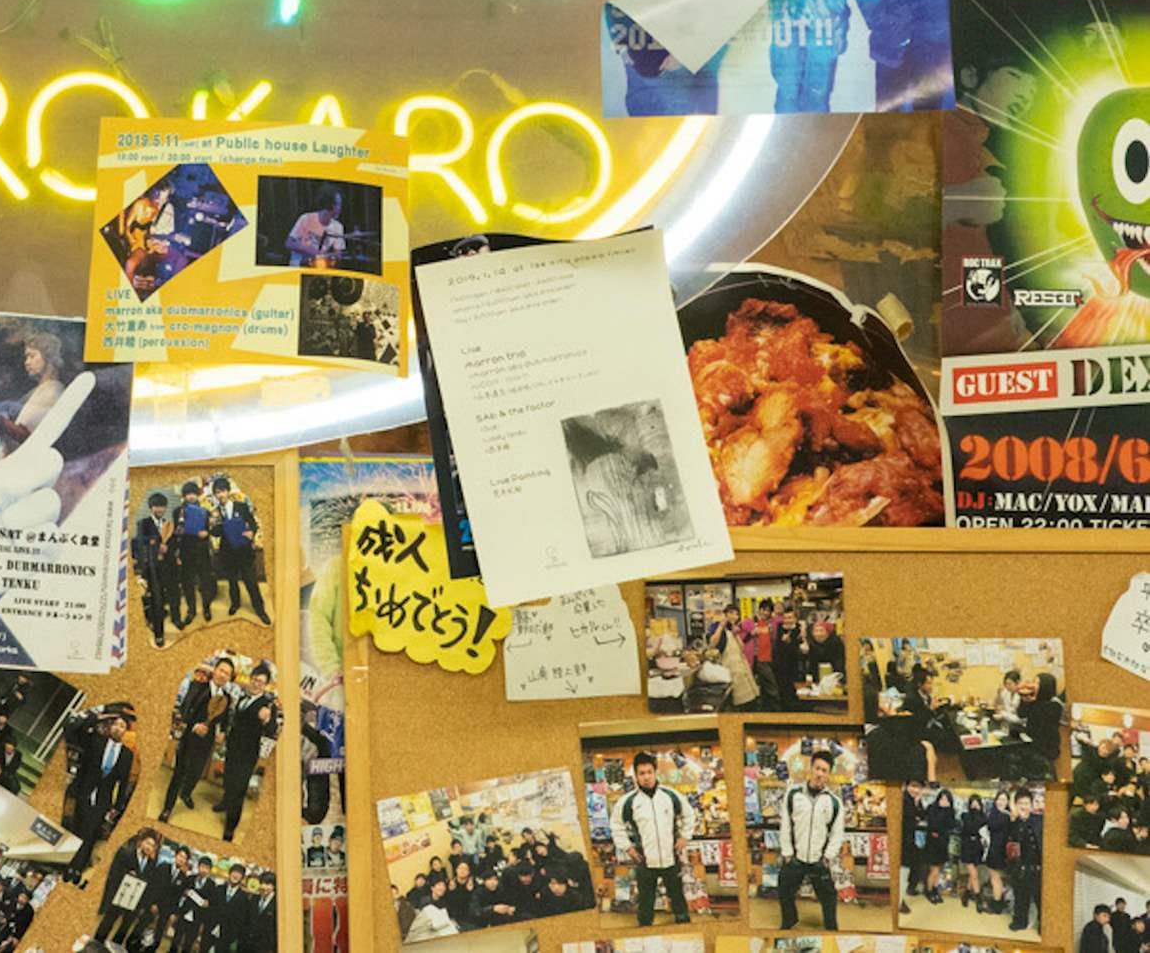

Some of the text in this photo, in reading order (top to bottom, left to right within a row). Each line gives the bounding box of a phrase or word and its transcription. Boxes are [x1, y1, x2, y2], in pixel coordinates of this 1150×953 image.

[216, 136, 260, 150] Public
[265, 139, 308, 152] house
[313, 142, 370, 160] Laughter
[956, 368, 1054, 398] GUEST
[1, 576, 41, 591] TENKU
